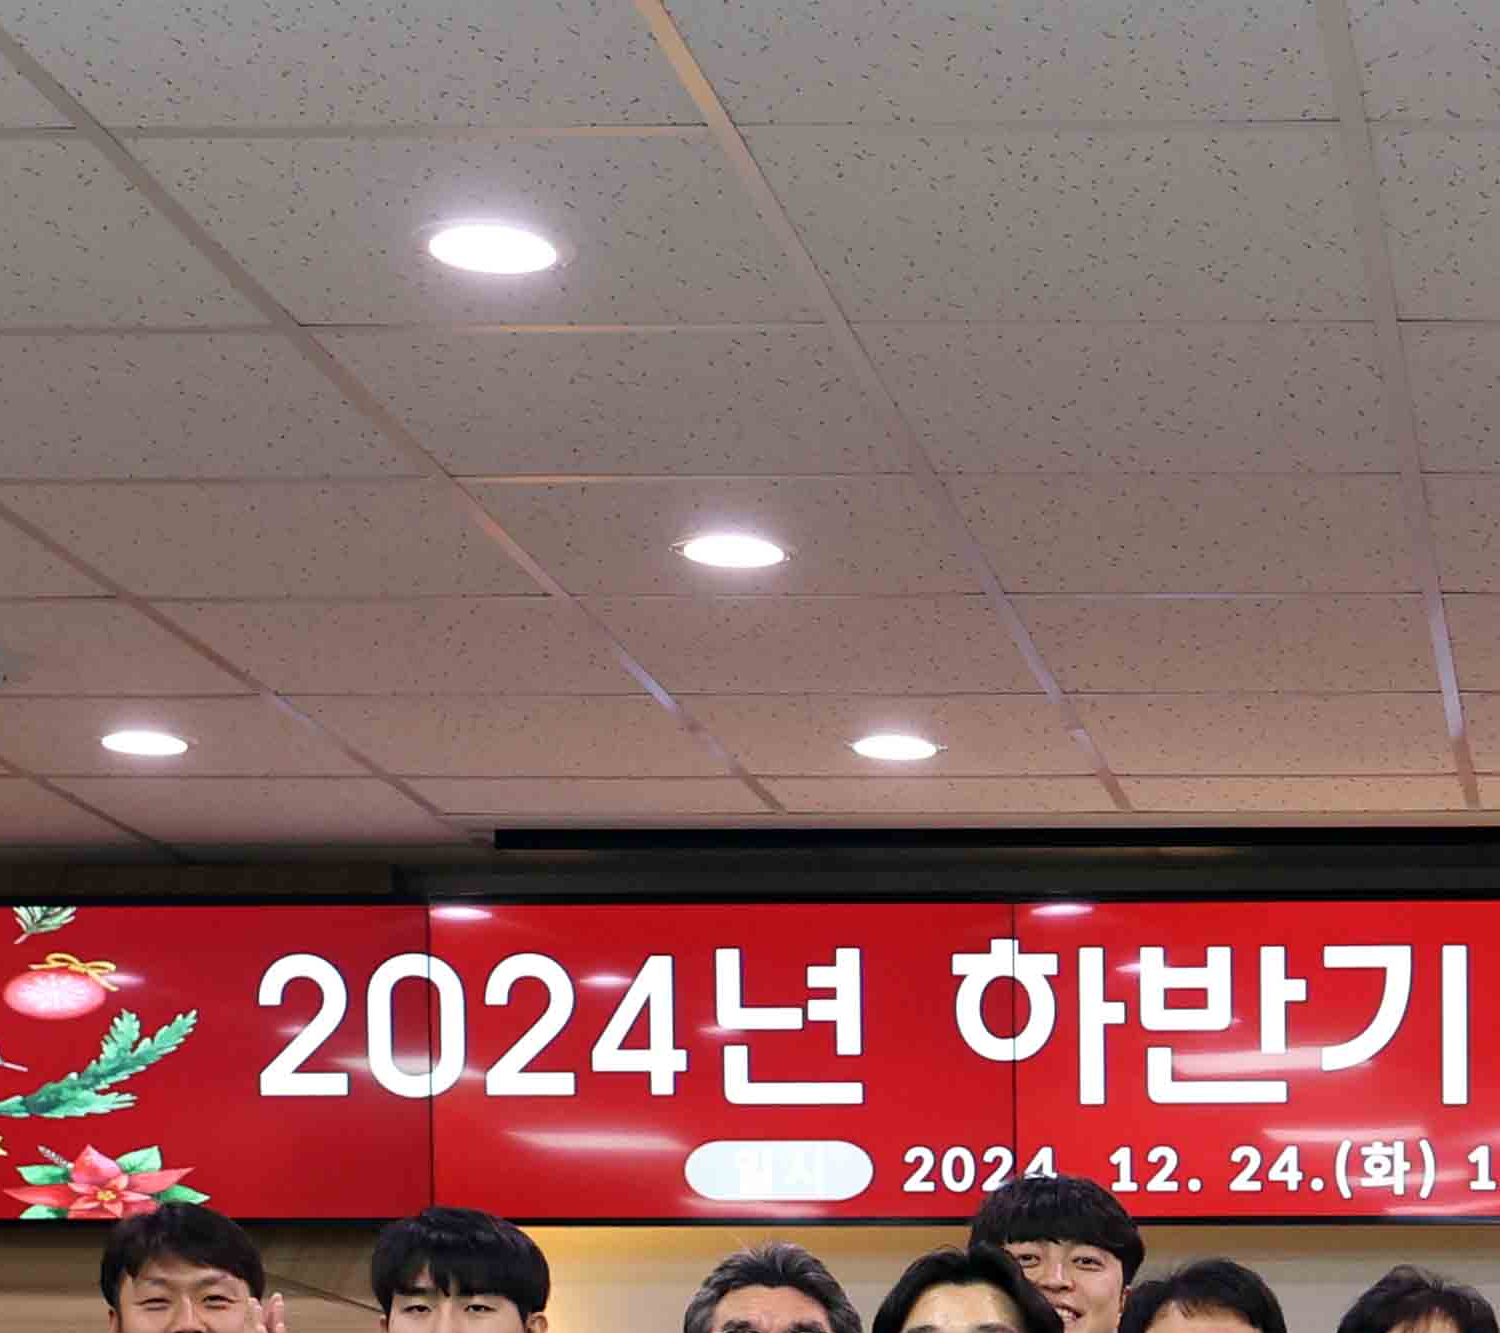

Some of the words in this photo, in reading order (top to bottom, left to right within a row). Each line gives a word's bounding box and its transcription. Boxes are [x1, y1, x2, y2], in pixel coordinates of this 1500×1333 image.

[257, 946, 864, 1106] 2024년
[951, 937, 1469, 1106] 하반기
[1108, 1145, 1202, 1193] 12.
[1228, 1138, 1438, 1200] 24.(화)
